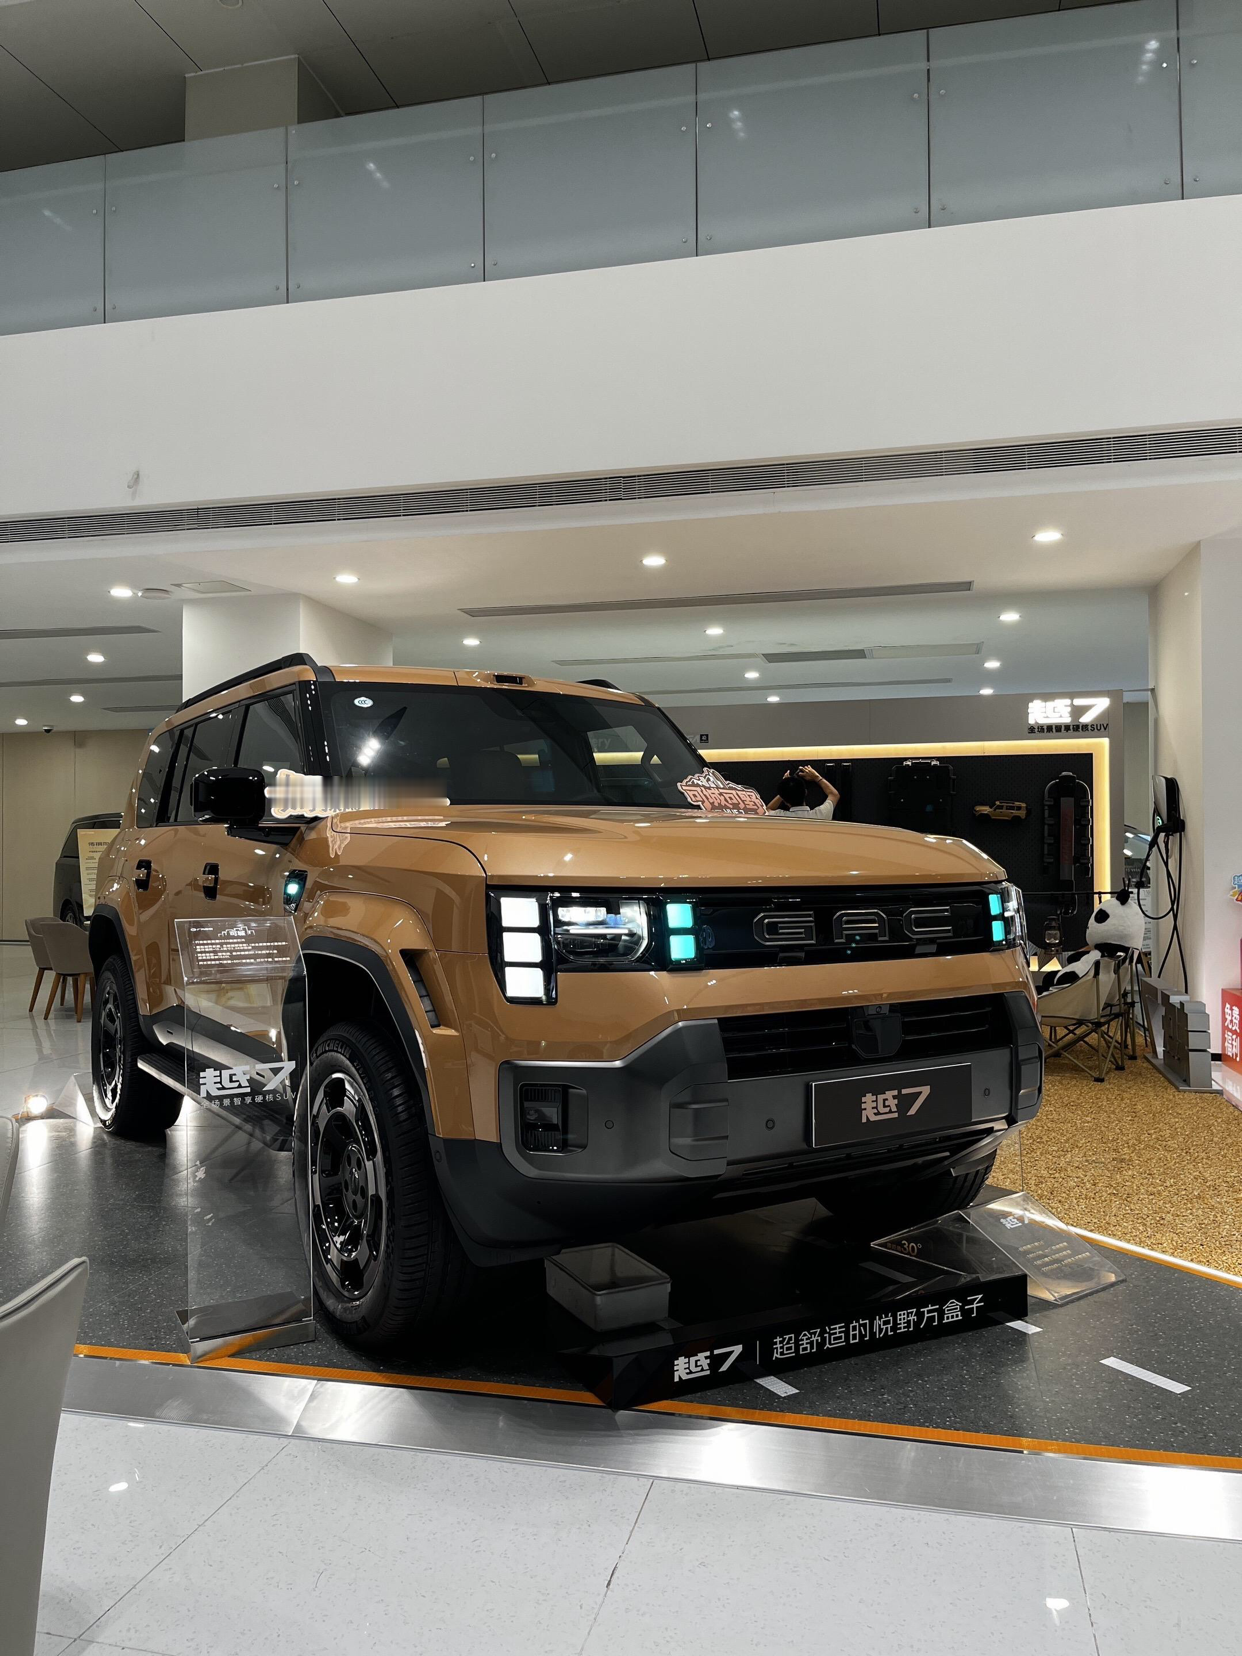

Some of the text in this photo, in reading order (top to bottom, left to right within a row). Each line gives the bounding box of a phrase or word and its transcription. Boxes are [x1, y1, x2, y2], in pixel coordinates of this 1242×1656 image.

[1028, 698, 1110, 724] 越7
[753, 906, 953, 946] GAC
[1224, 1002, 1240, 1033] 免费
[317, 1040, 352, 1059] MICHELIN
[1224, 1030, 1240, 1062] 福利
[199, 1060, 296, 1098] 越7
[200, 1091, 297, 1109] 全场景智享硬核SUV
[861, 1085, 931, 1123] 越7
[674, 1294, 985, 1382] 越7 超舒适的悦野方盒子
